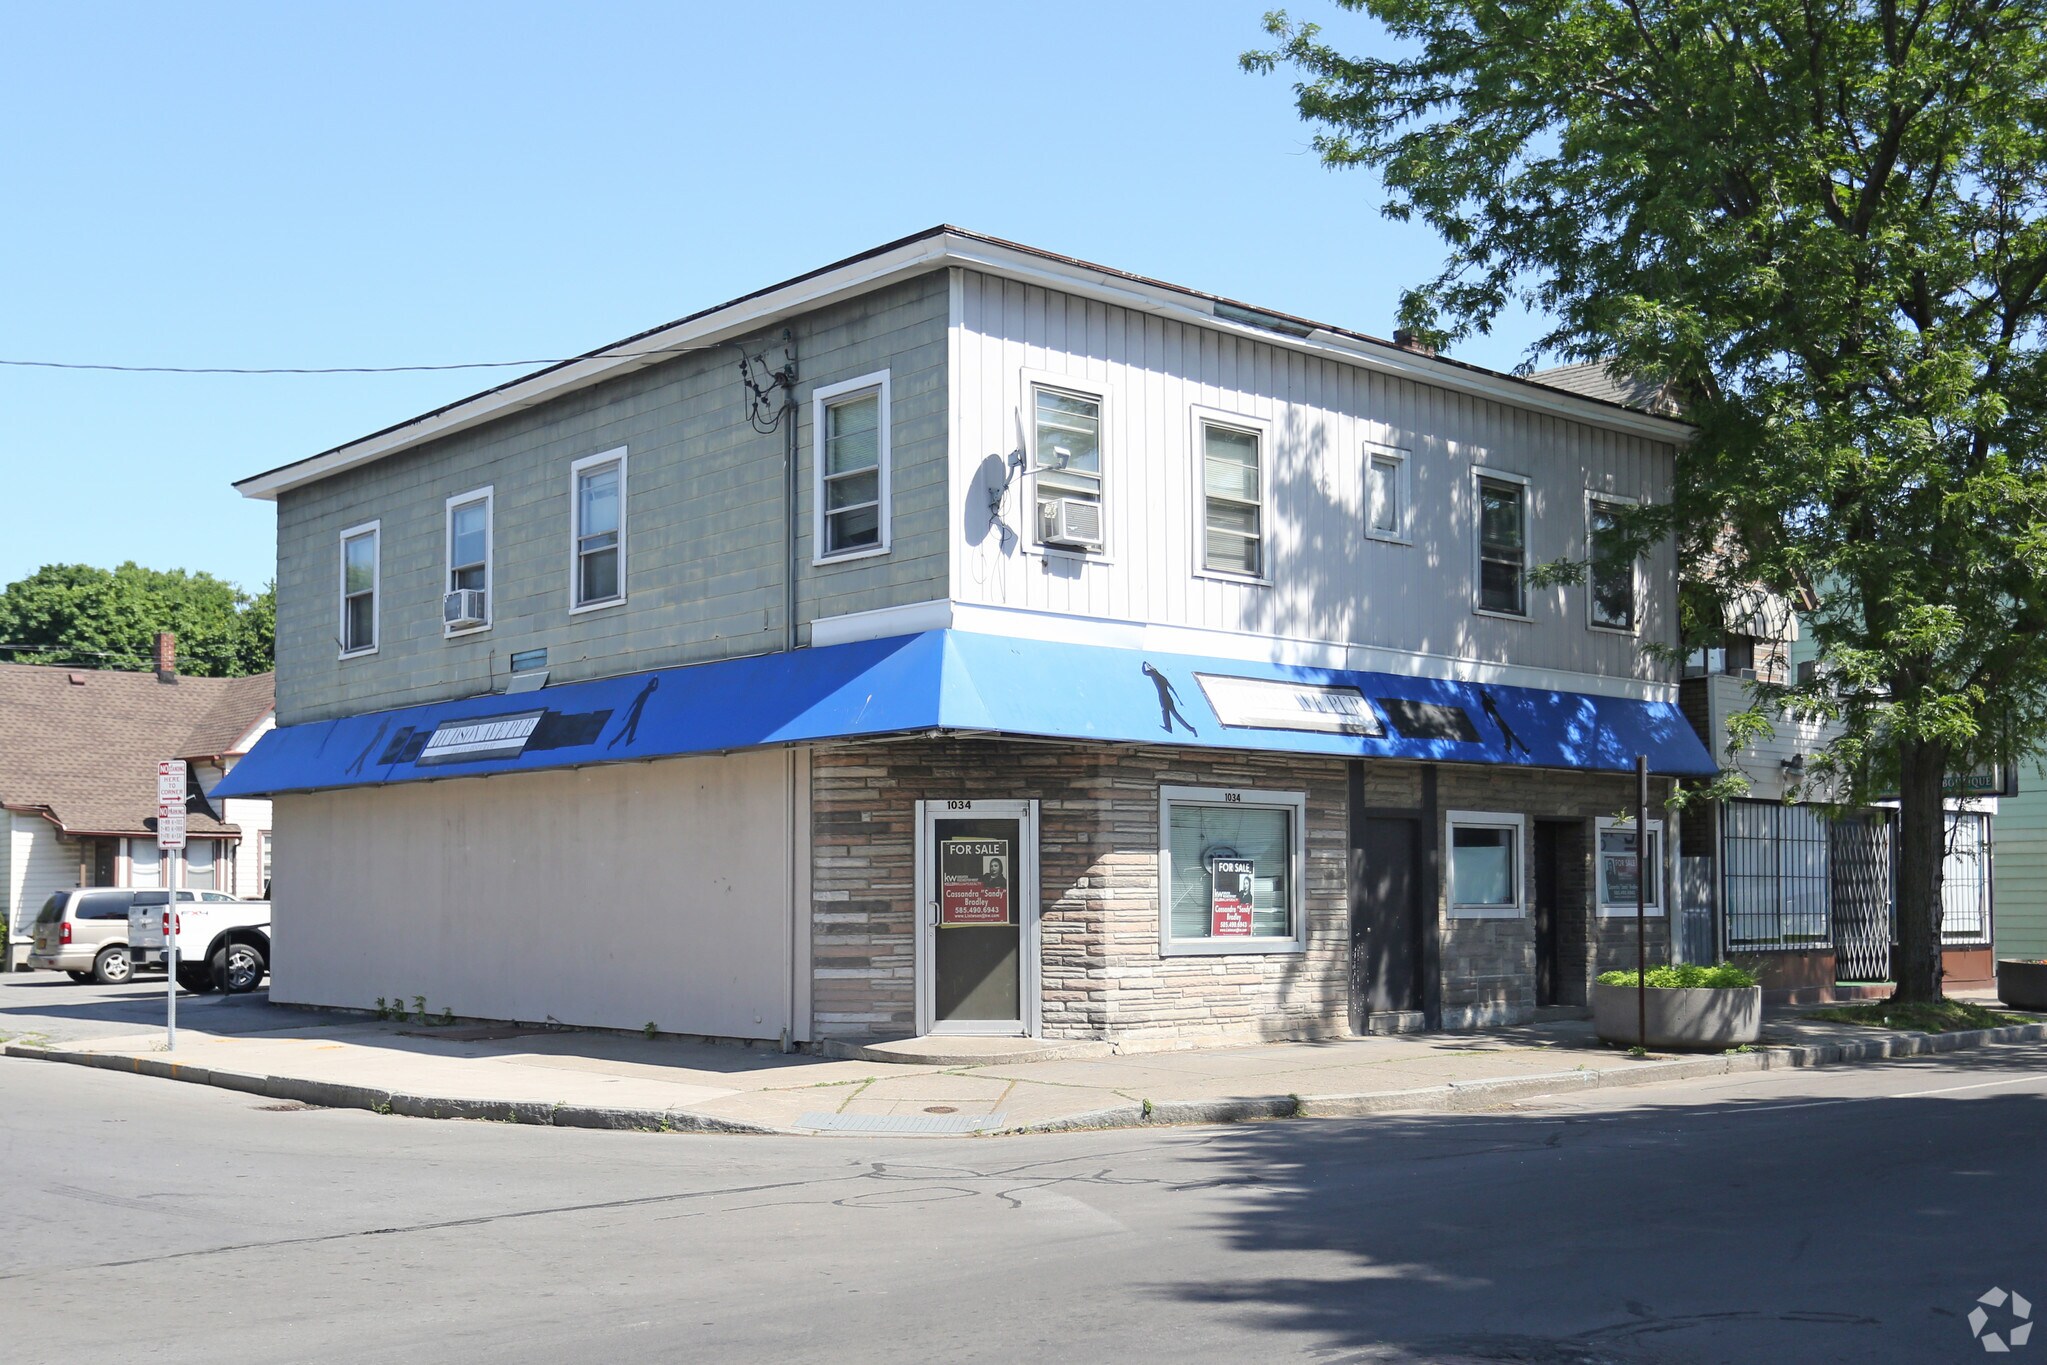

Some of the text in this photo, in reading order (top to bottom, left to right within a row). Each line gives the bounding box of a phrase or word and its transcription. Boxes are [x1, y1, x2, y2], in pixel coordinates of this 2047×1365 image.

[433, 719, 535, 747] HUDSON AVE PUB
[160, 764, 168, 774] NO
[1942, 777, 1991, 789] BOIQUE
[1225, 793, 1240, 802] 1034
[947, 801, 971, 810] 1034
[159, 807, 168, 816] NO
[950, 845, 999, 855] FOR SALE
[1218, 863, 1234, 872] FOR
[944, 872, 957, 882] kw
[946, 889, 979, 898] Cassandra
[964, 898, 989, 907] Bradley
